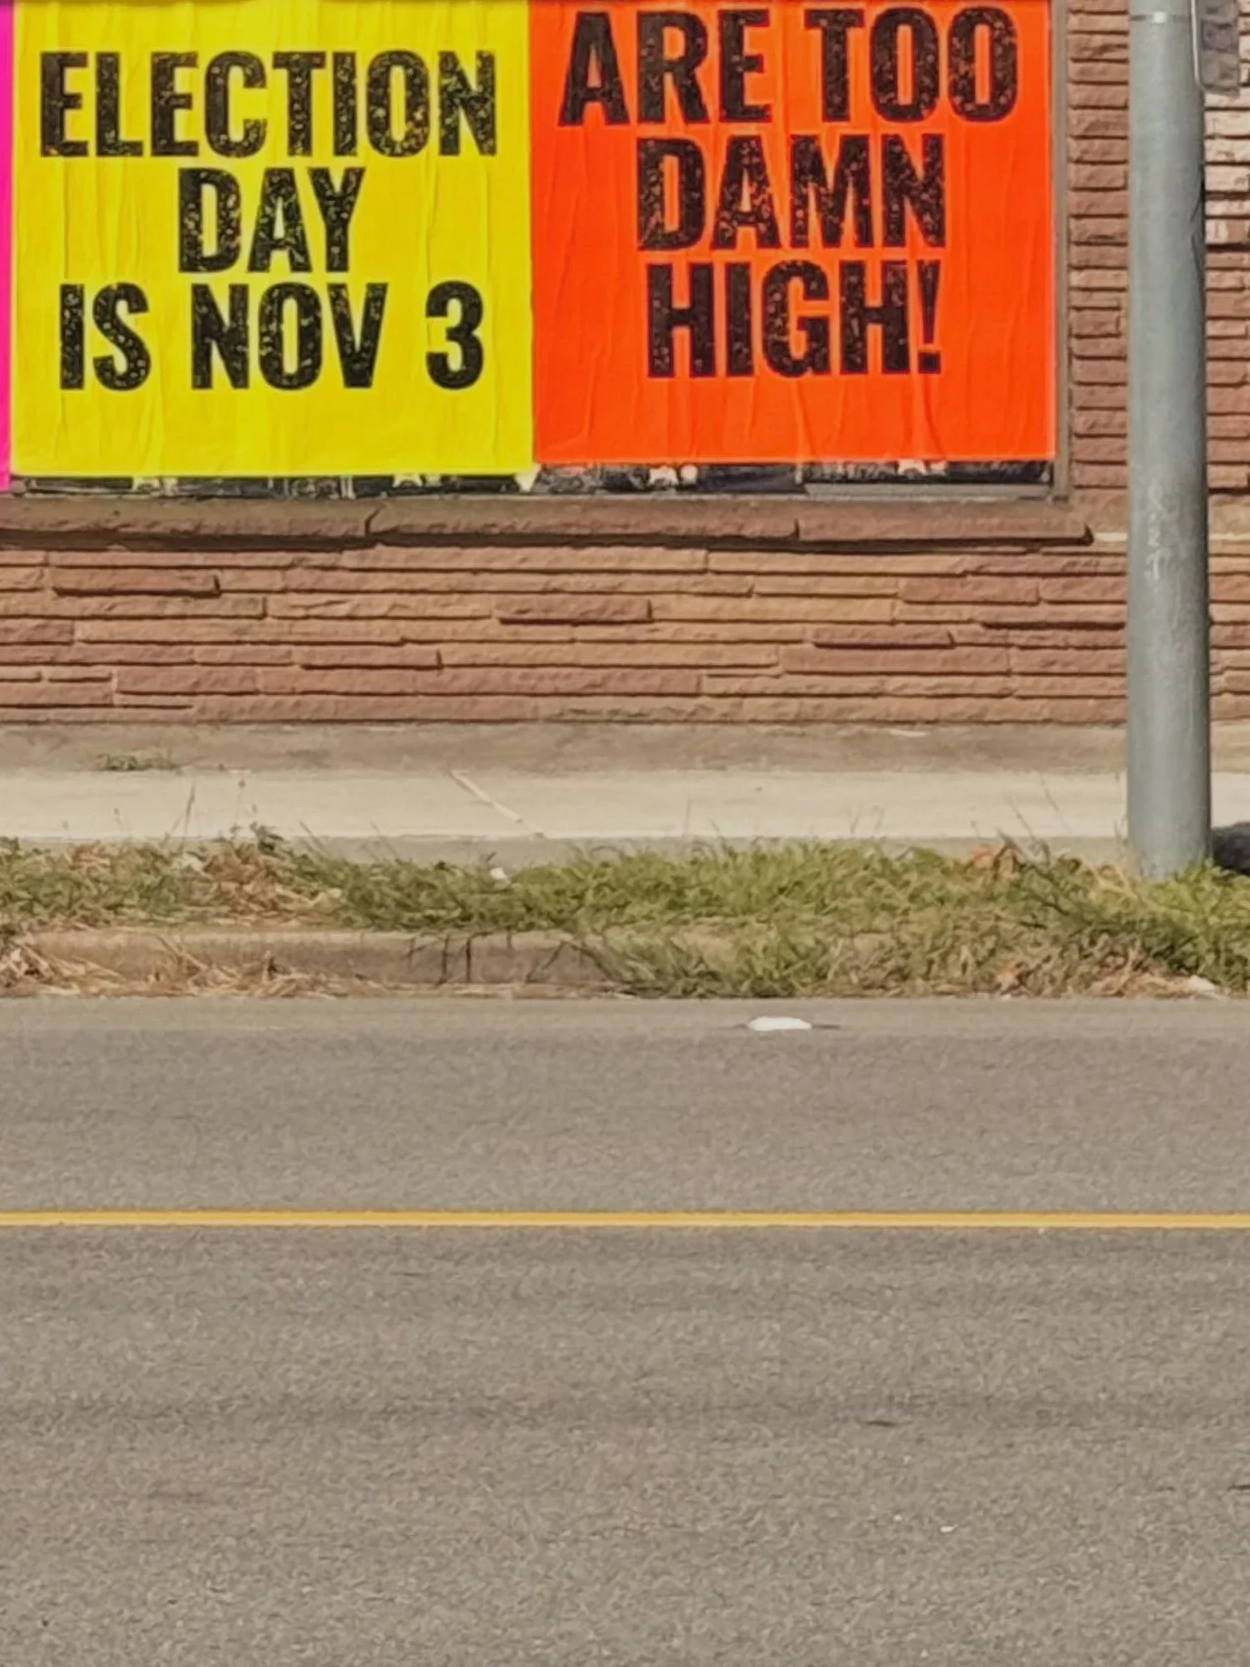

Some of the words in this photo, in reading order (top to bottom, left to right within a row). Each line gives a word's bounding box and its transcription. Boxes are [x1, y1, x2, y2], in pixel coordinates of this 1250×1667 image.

[40, 51, 497, 157] ELECTION
[558, 9, 772, 126] ARE
[806, 7, 1018, 123] TOO
[178, 168, 364, 274] DAY
[638, 134, 945, 249] DAMN
[59, 282, 151, 390] IS
[191, 282, 387, 390] NOV
[426, 281, 484, 390] 3
[646, 260, 942, 377] HIGH!
